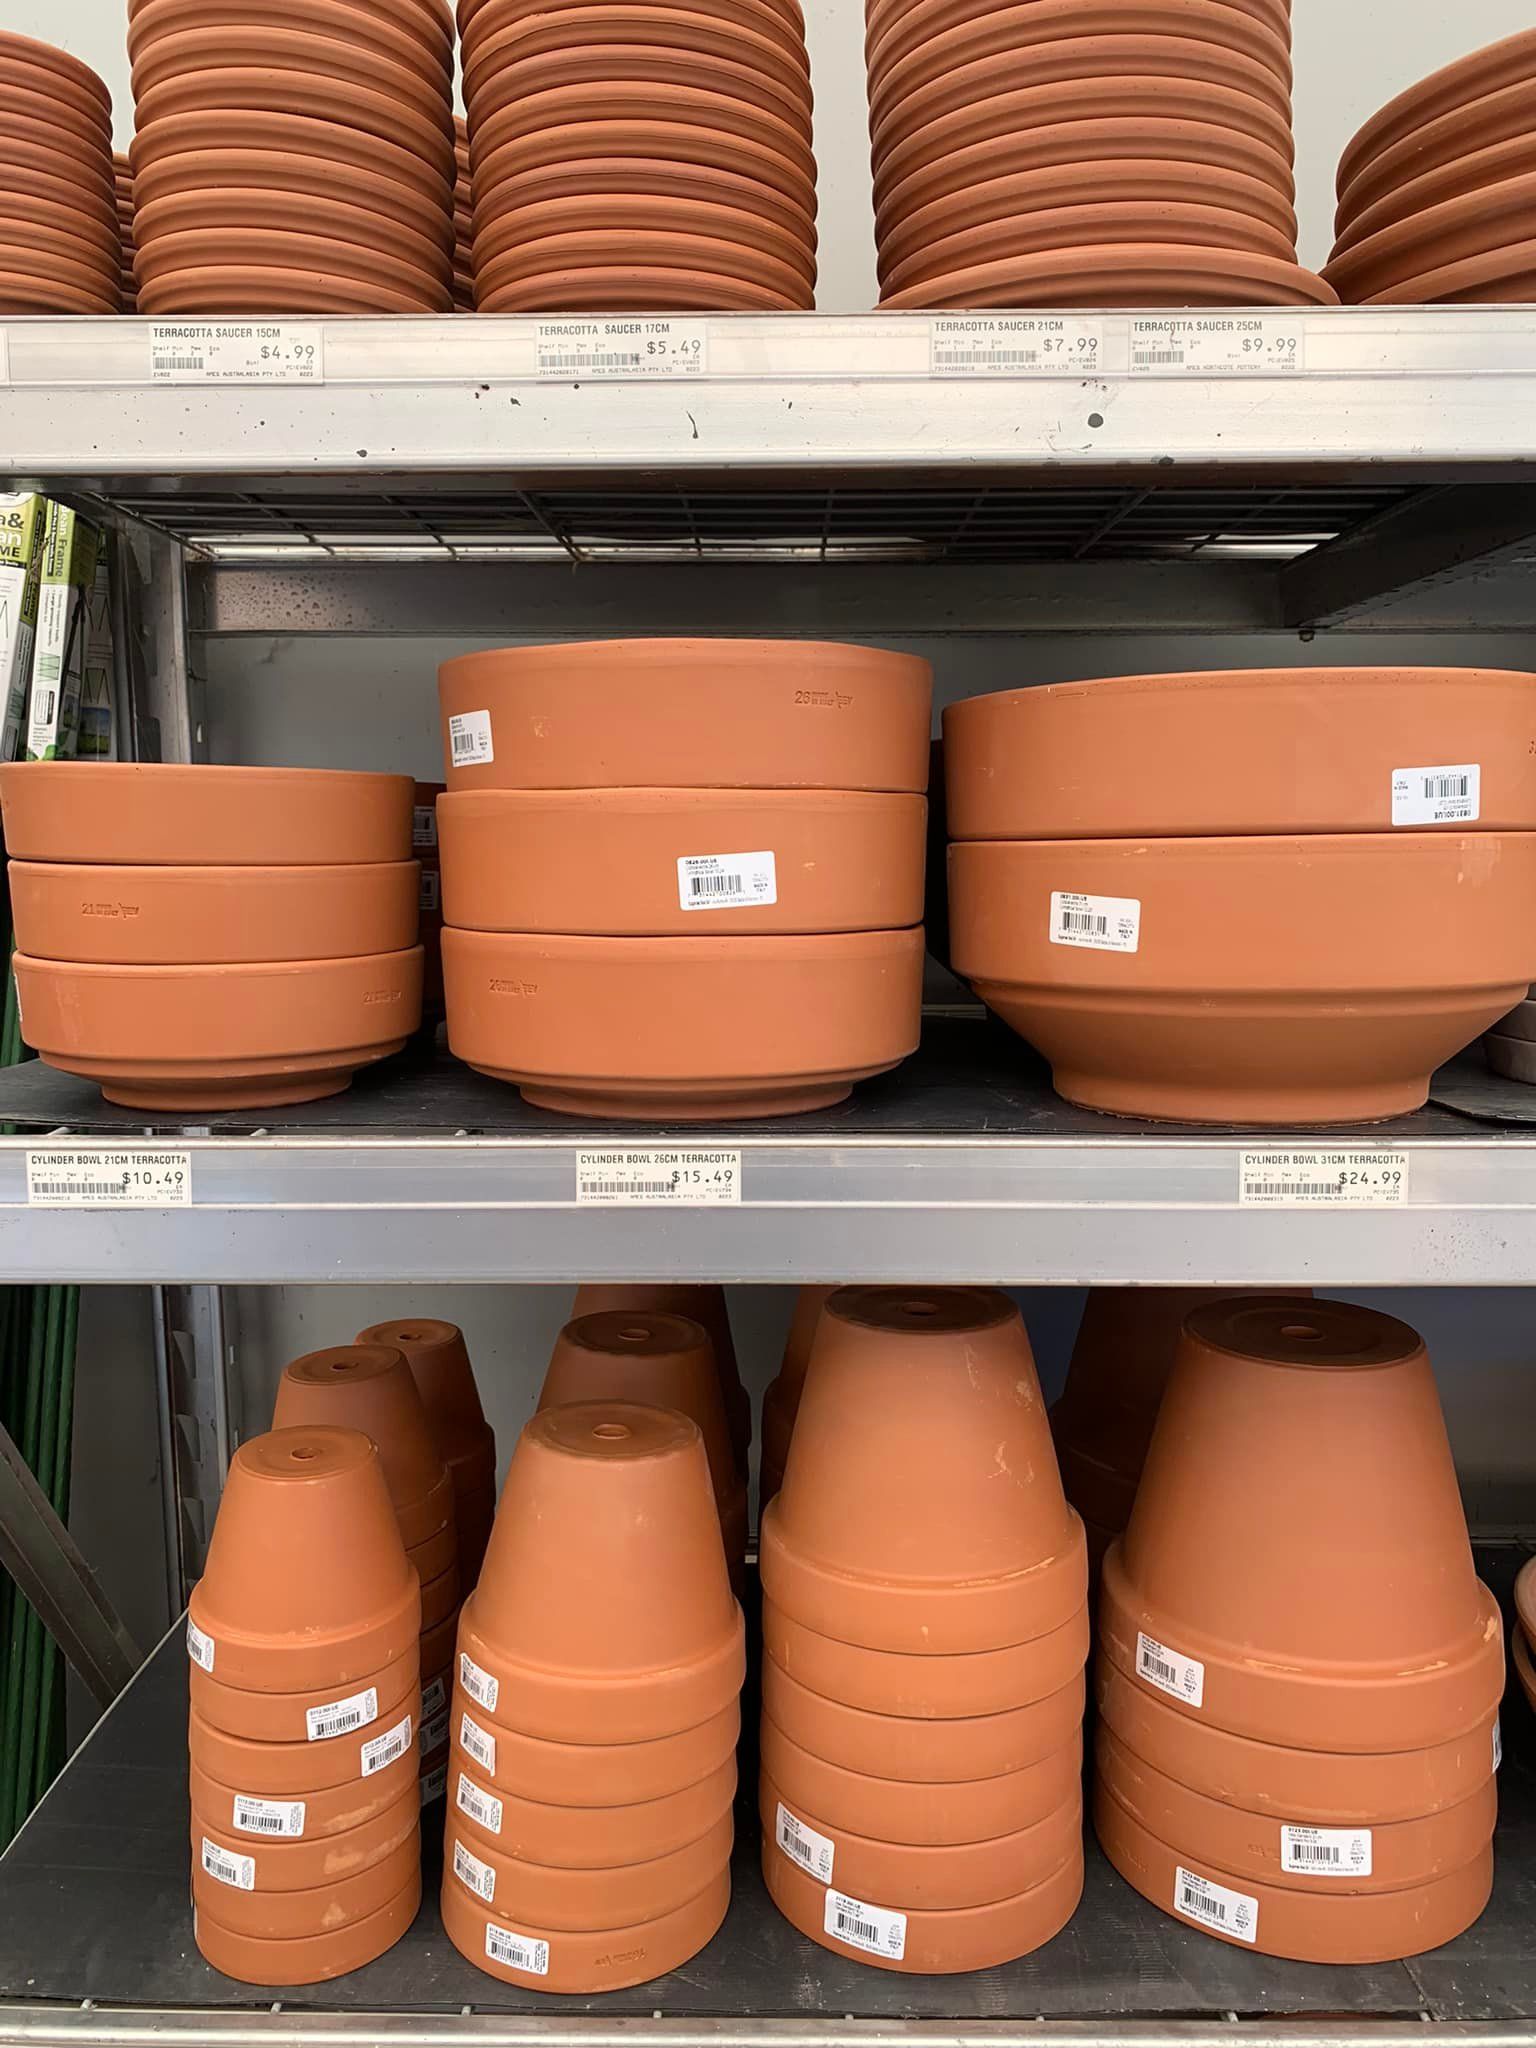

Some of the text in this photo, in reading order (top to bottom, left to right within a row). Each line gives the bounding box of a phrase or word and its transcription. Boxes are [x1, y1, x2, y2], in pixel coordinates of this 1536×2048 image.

[153, 327, 280, 338] TERRACOTTA SAUCER 15CM
[539, 324, 670, 336] TERRACOTTA SAUCER 17CM
[935, 320, 1064, 332] TERRACOTTA SAUCER 21CM
[1134, 320, 1262, 332] TERRACOTTA SAUCER 25CM
[646, 340, 701, 354] $5.49
[1043, 338, 1098, 352] $7.99
[1242, 338, 1297, 352] $9.99
[260, 345, 315, 359] $4.99
[55, 539, 68, 577] Frame
[31, 1156, 187, 1165] CYLINDER BOWL 21CM TERRACOTTA
[580, 1154, 736, 1164] CYLINDER BOWL 26CM TERRACOTTA
[1245, 1155, 1406, 1164] CYLINDER BOWL 31CM TERRACOTTA
[122, 1172, 184, 1185] $10.49
[672, 1170, 733, 1184] $15.49
[1338, 1171, 1402, 1185] $24.99
